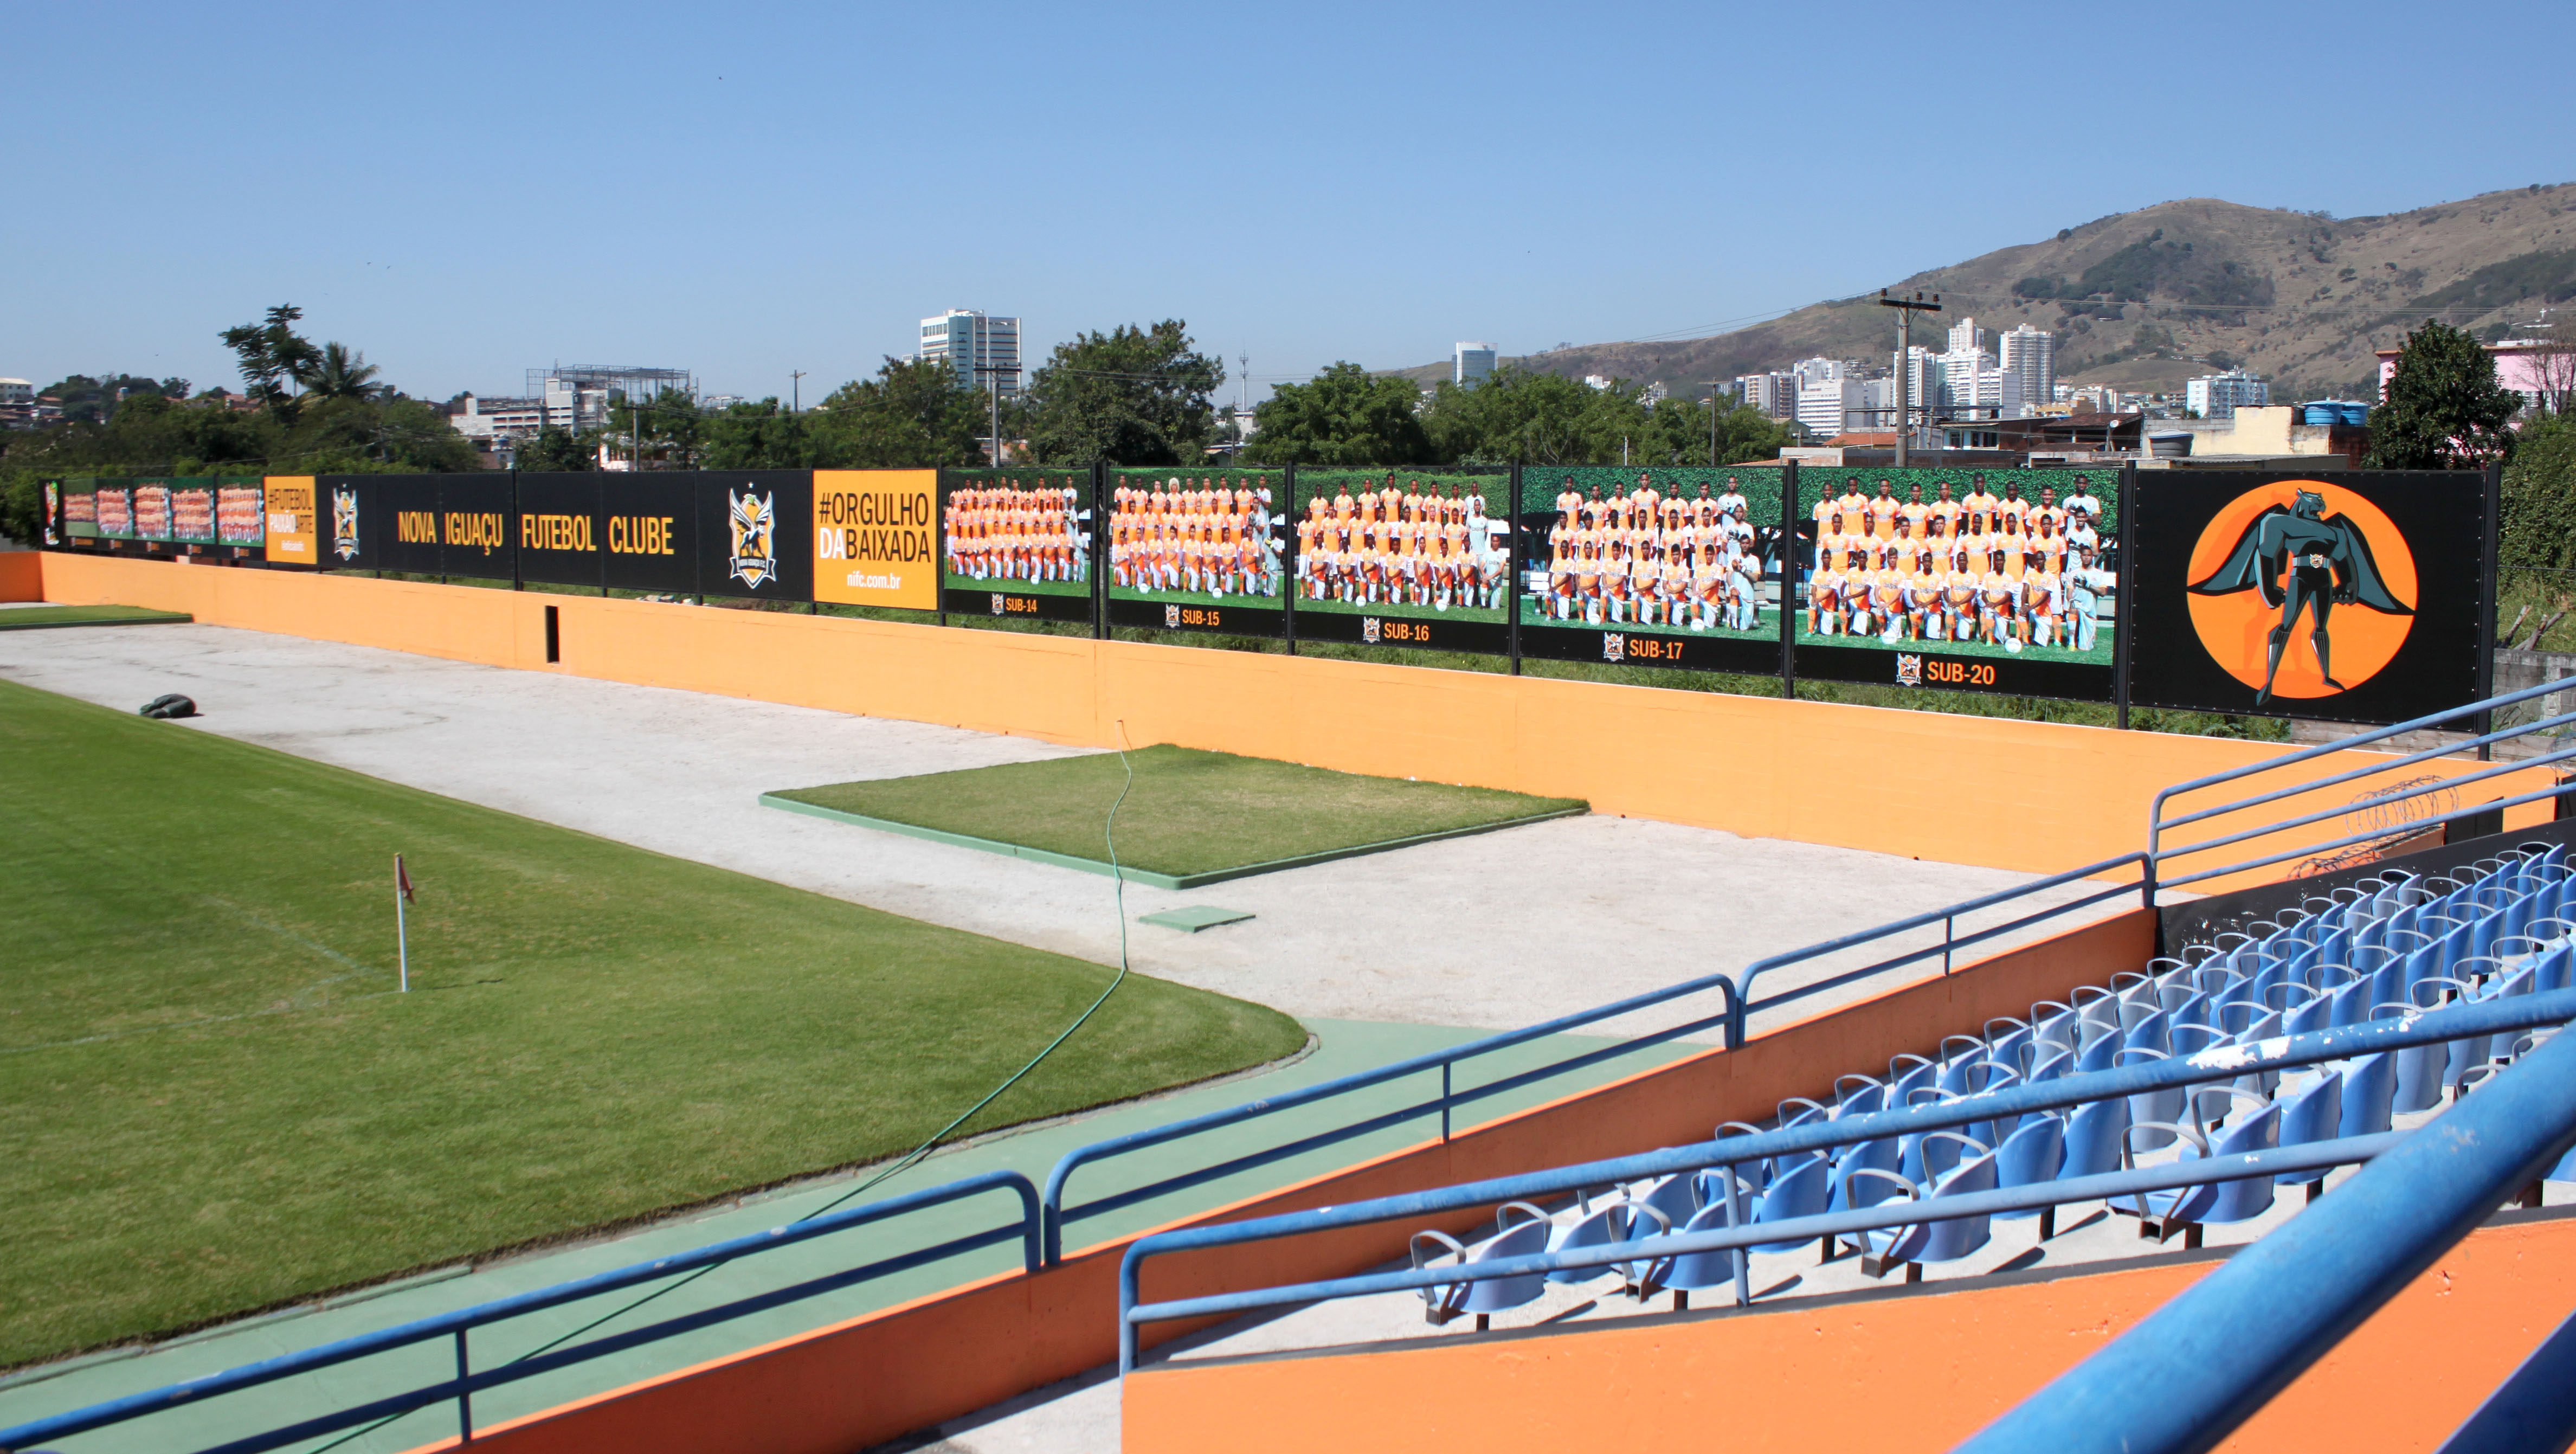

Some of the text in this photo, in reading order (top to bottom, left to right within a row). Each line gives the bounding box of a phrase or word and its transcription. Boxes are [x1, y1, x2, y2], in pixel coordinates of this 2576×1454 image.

[819, 492, 929, 526] #ORGULHO
[398, 511, 674, 556] NOVA IGUAÇU FUTEBOL CLUBE
[847, 570, 900, 589] nifc.com.br
[1006, 597, 1038, 613] SUB-14
[1182, 609, 1219, 626] SUB-15
[1383, 622, 1429, 641] SUB-16
[1629, 639, 1683, 659] SUB-17
[1927, 661, 1996, 685] SUB-20
